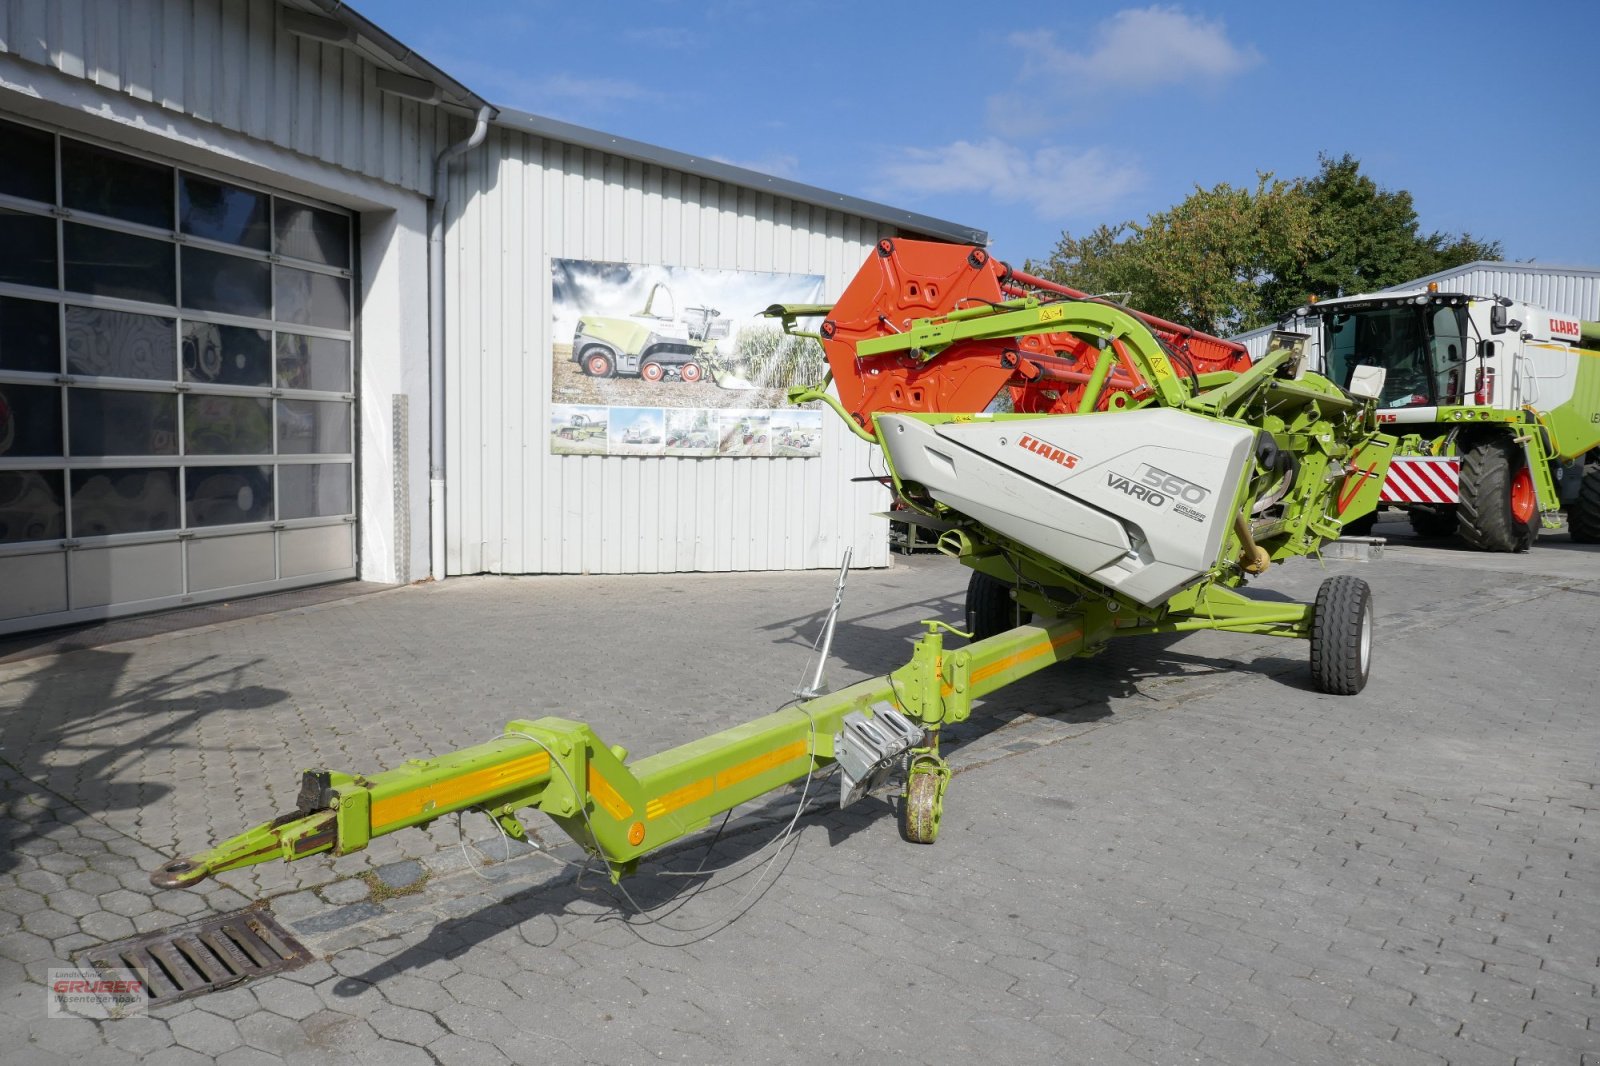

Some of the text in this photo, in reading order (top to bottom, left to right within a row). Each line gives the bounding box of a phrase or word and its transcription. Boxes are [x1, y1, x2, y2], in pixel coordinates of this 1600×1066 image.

[1549, 318, 1579, 336] CLAAS
[1018, 435, 1078, 469] CLAAS
[1106, 473, 1166, 507] VARIO
[1141, 466, 1206, 505] 560
